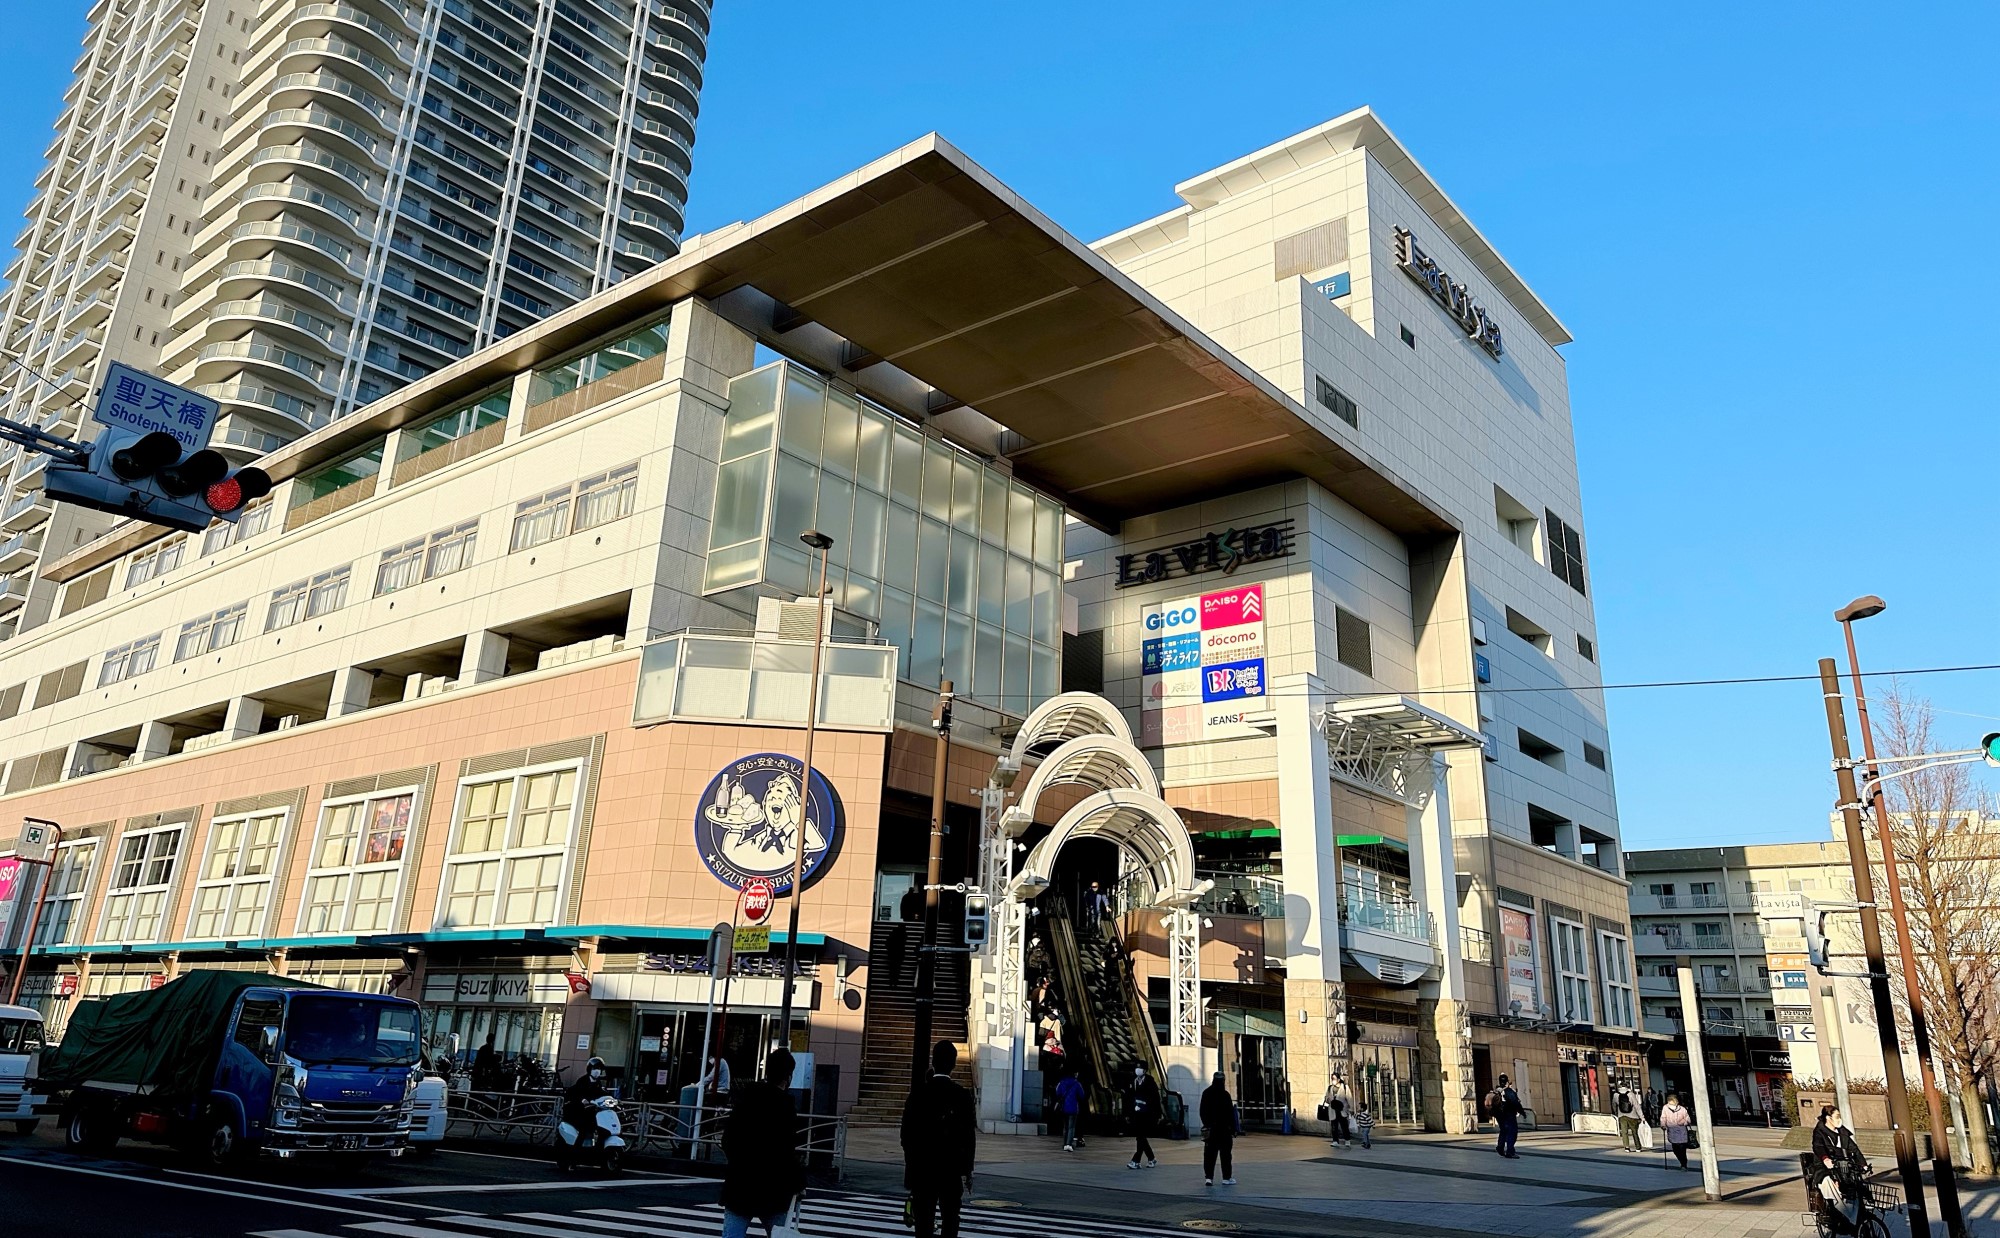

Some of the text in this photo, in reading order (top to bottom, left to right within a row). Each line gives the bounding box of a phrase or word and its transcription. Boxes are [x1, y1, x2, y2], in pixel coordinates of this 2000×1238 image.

[114, 375, 207, 430] 聖天橋
[1204, 595, 1238, 608] DAISO
[1145, 607, 1197, 631] GiGO
[1207, 632, 1257, 647] docomo
[1159, 650, 1199, 667] シティライフ
[1207, 714, 1238, 726] JEANS
[745, 895, 767, 910] 消火栓
[645, 951, 803, 976] SUZKIYA
[1781, 1026, 1792, 1039] P
[341, 1089, 372, 1098] ISUZU
